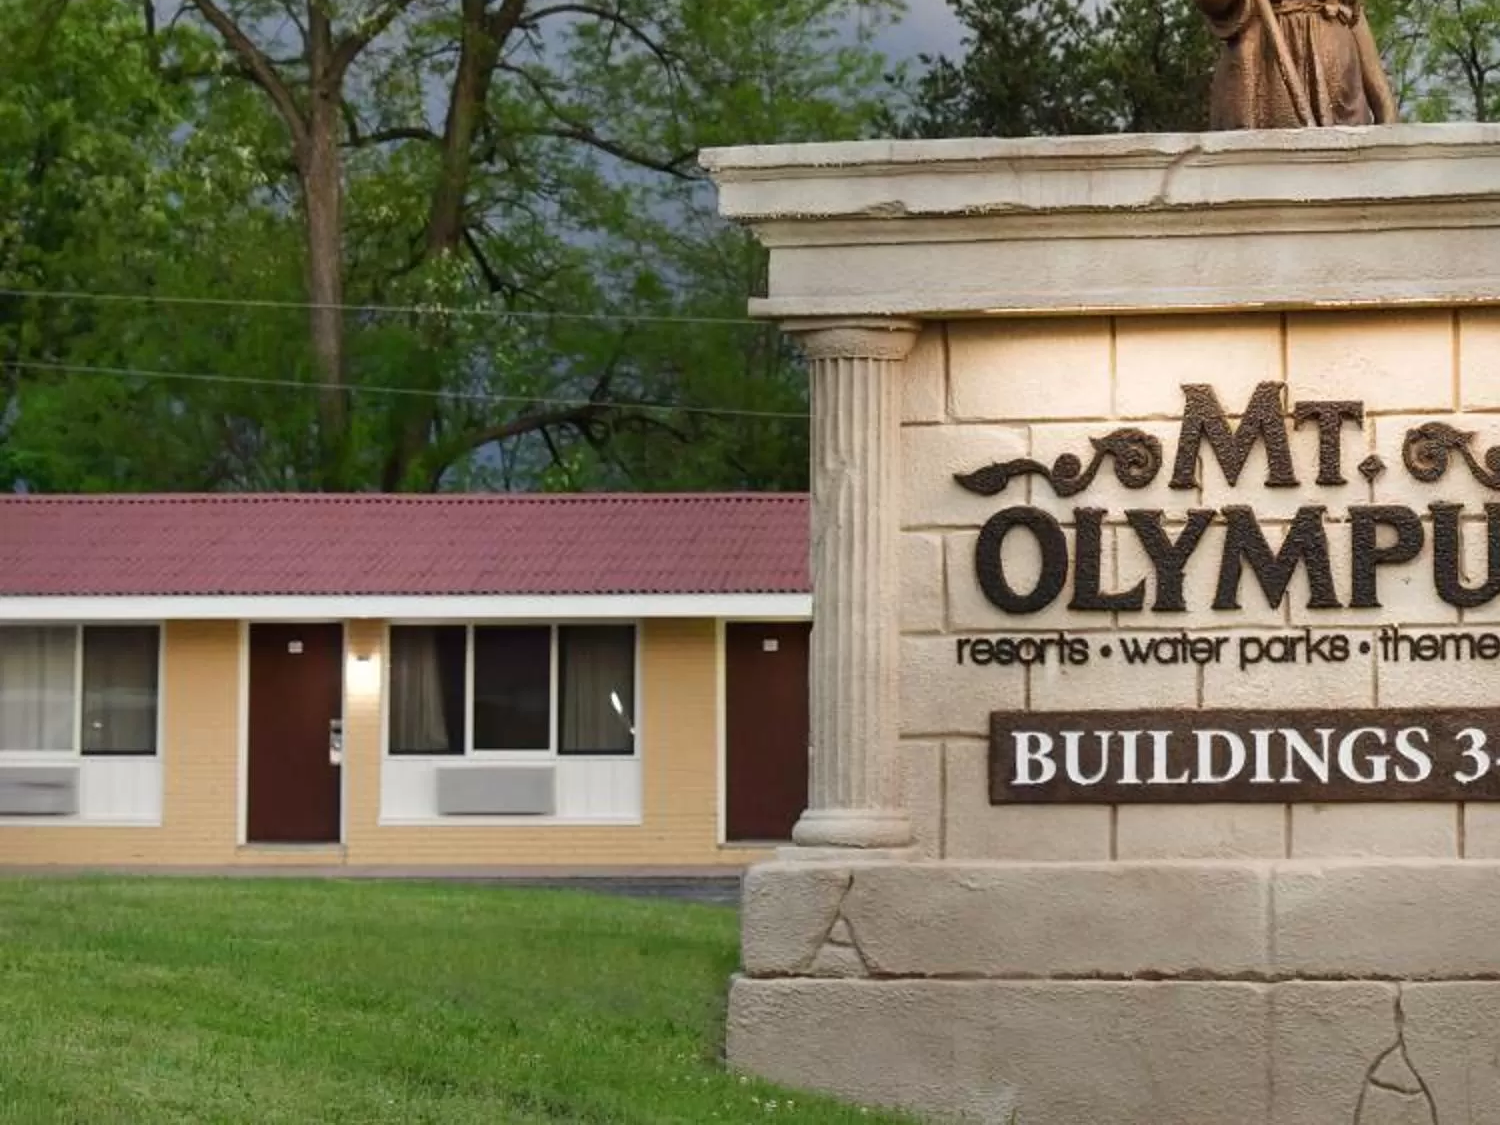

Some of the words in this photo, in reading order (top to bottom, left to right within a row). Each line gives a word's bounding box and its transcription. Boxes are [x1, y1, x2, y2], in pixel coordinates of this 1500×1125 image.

[1168, 380, 1385, 491] MT.
[956, 630, 1089, 667] resorts
[1119, 633, 1229, 666] water
[1240, 626, 1350, 670] parks
[1378, 626, 1500, 660] theme
[1010, 725, 1433, 788] BUILDINGS
